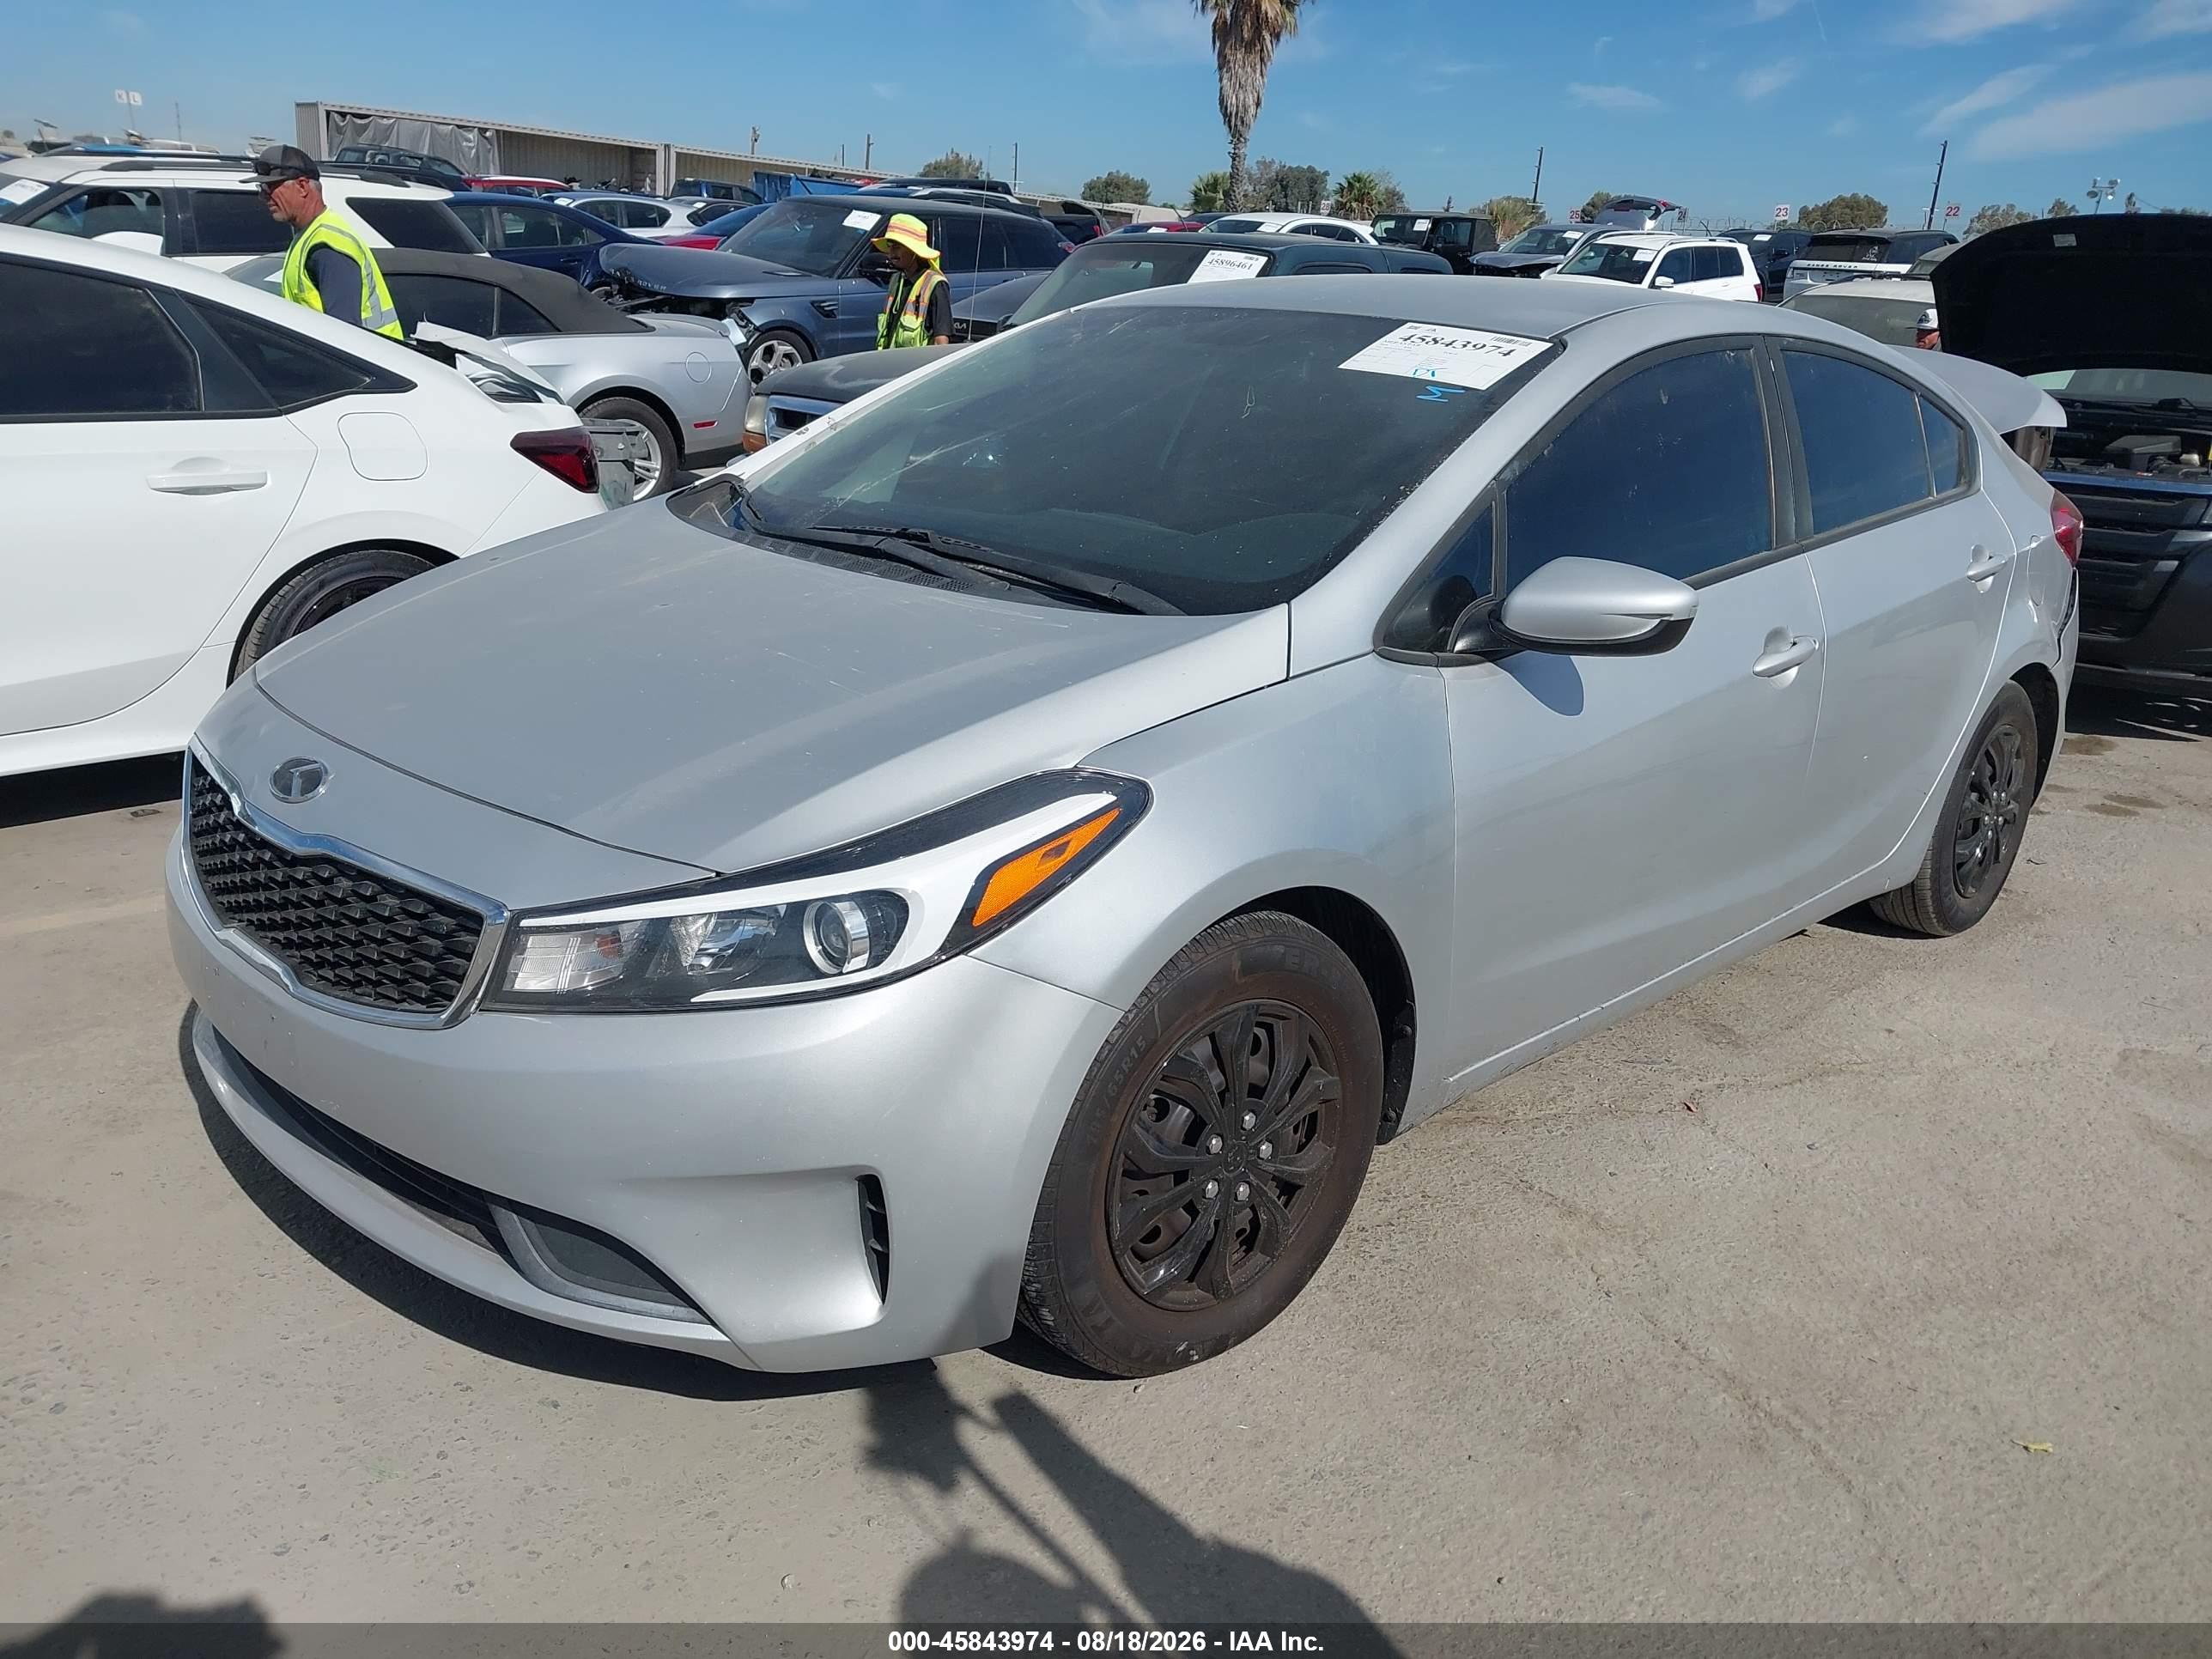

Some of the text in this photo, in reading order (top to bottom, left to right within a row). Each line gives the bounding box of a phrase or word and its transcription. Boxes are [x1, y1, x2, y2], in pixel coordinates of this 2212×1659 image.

[1322, 203, 1330, 211] 28
[1775, 207, 1789, 217] 23
[1945, 206, 1960, 216] 22
[1569, 210, 1580, 220] 25
[1207, 258, 1254, 270] 45896461
[1398, 332, 1517, 357] 45843974
